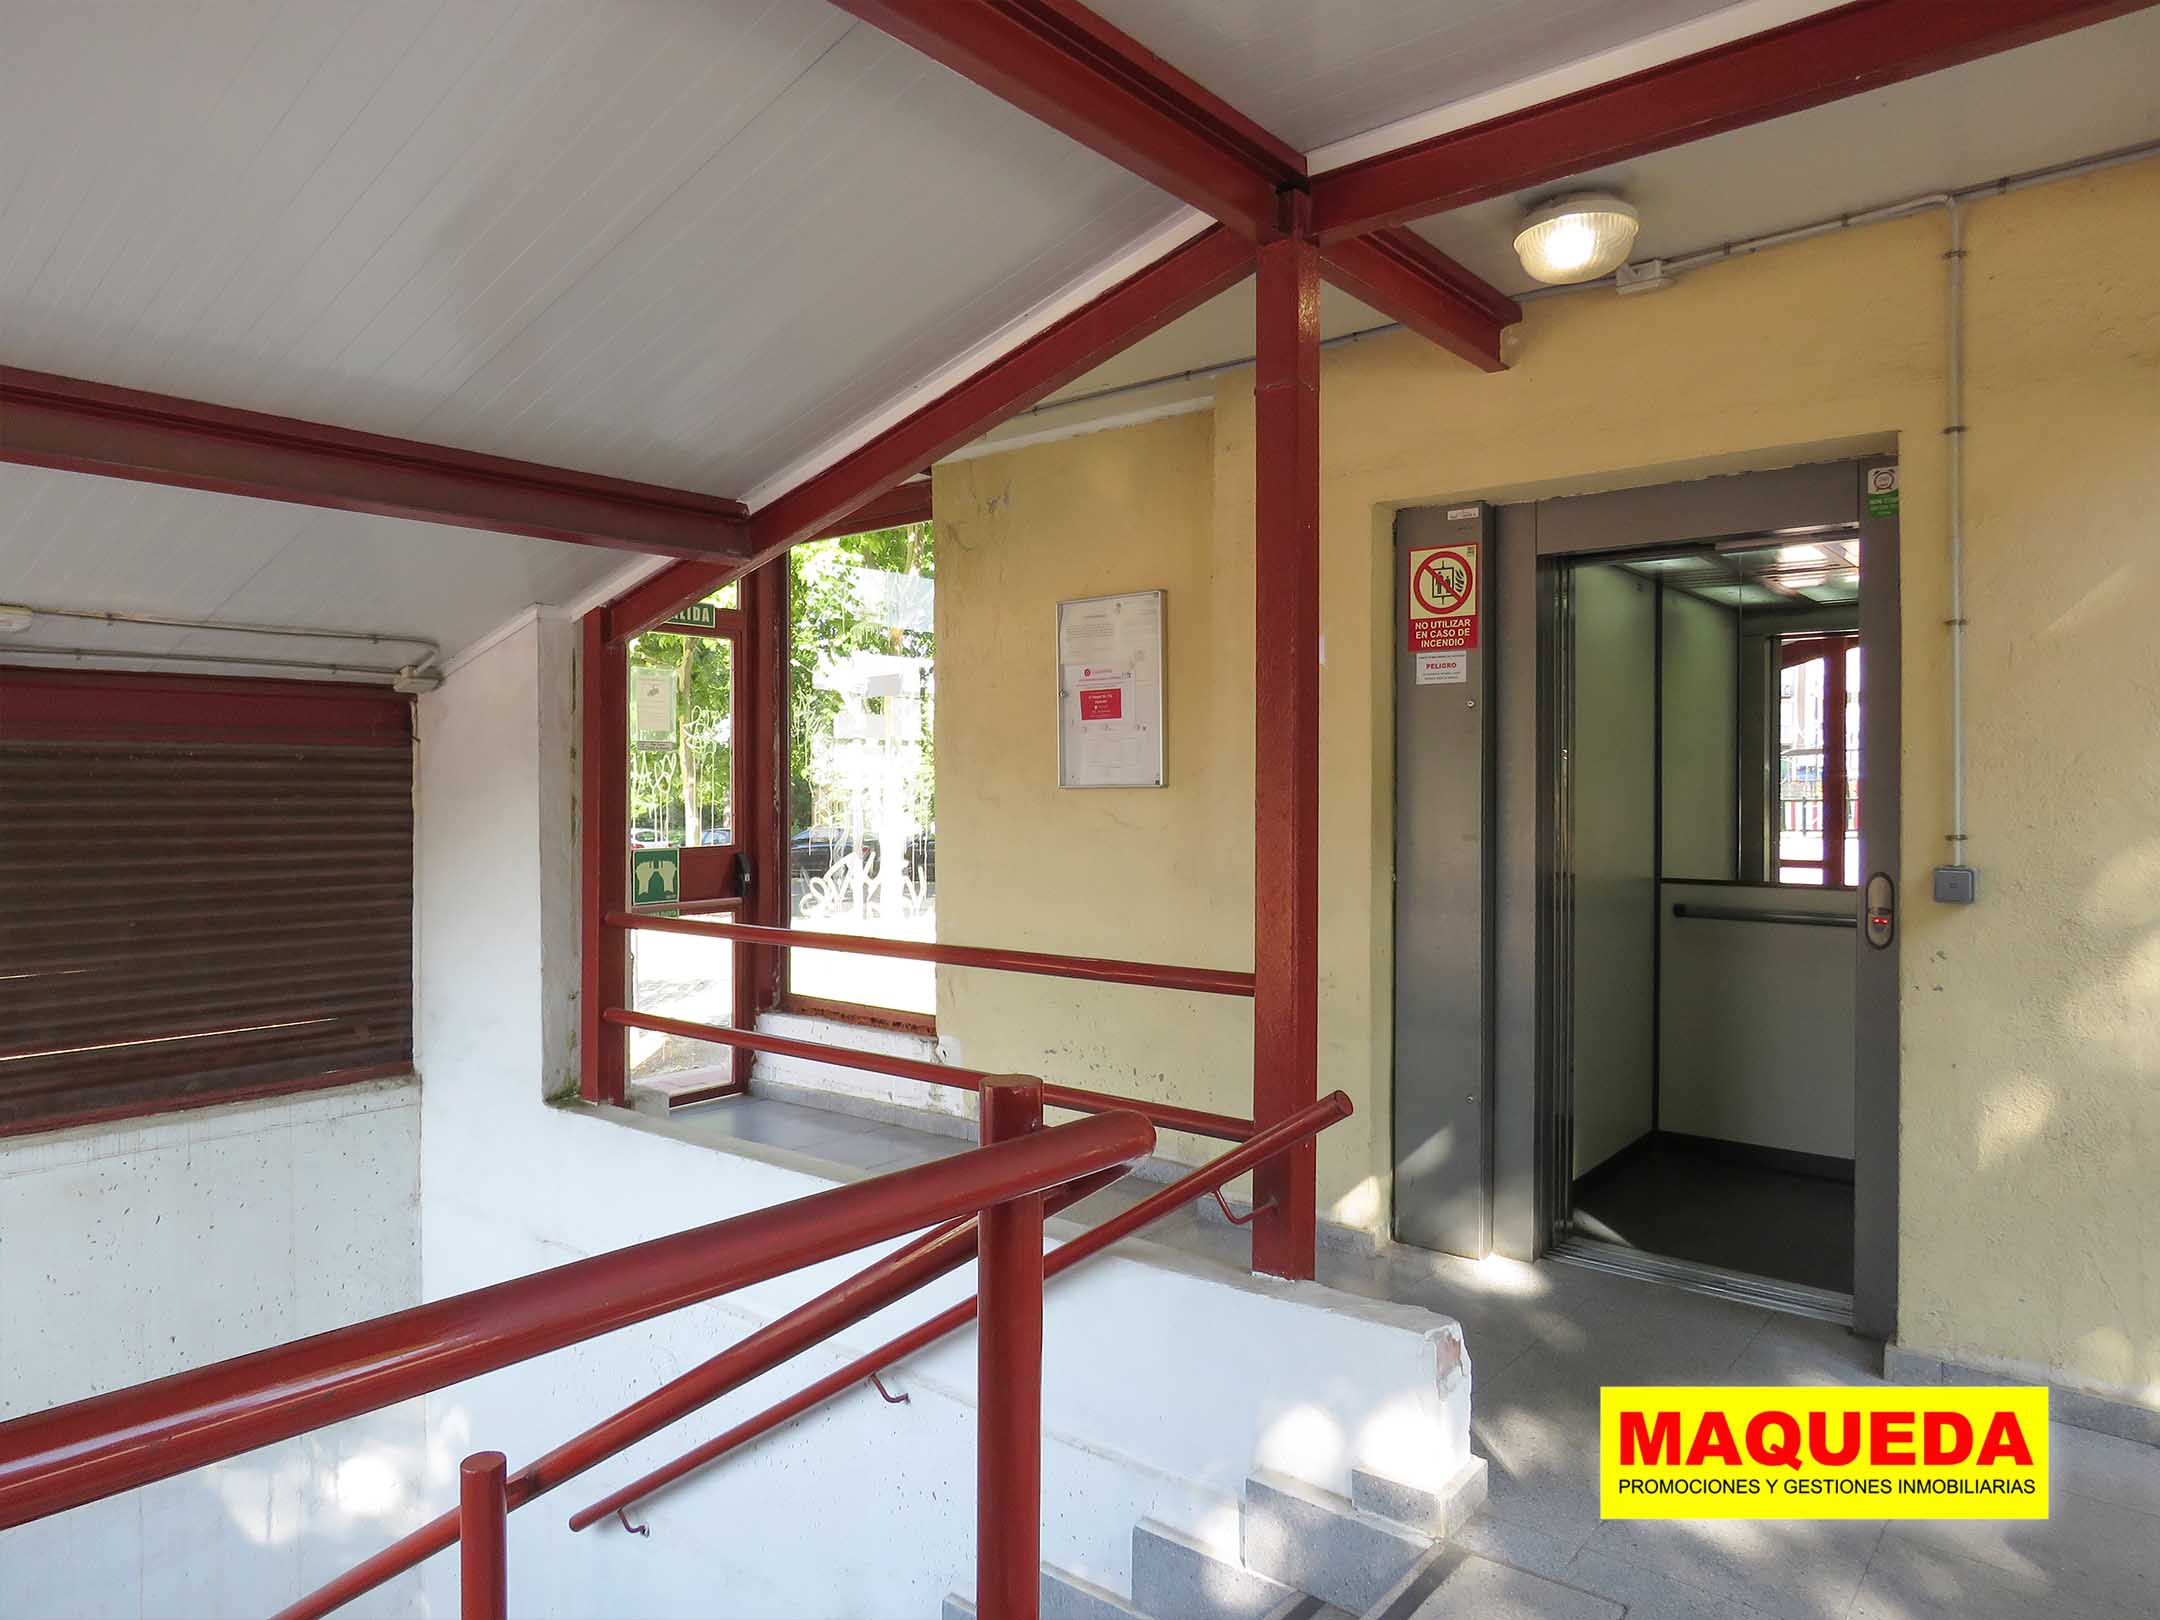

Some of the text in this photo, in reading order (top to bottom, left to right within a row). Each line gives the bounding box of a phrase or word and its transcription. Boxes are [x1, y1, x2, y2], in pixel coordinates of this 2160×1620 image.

[672, 606, 710, 622] LIDA
[1415, 618, 1471, 630] NO UTILIZAR
[1415, 628, 1470, 639] EN CASO DE
[1421, 637, 1465, 648] INCENDIO
